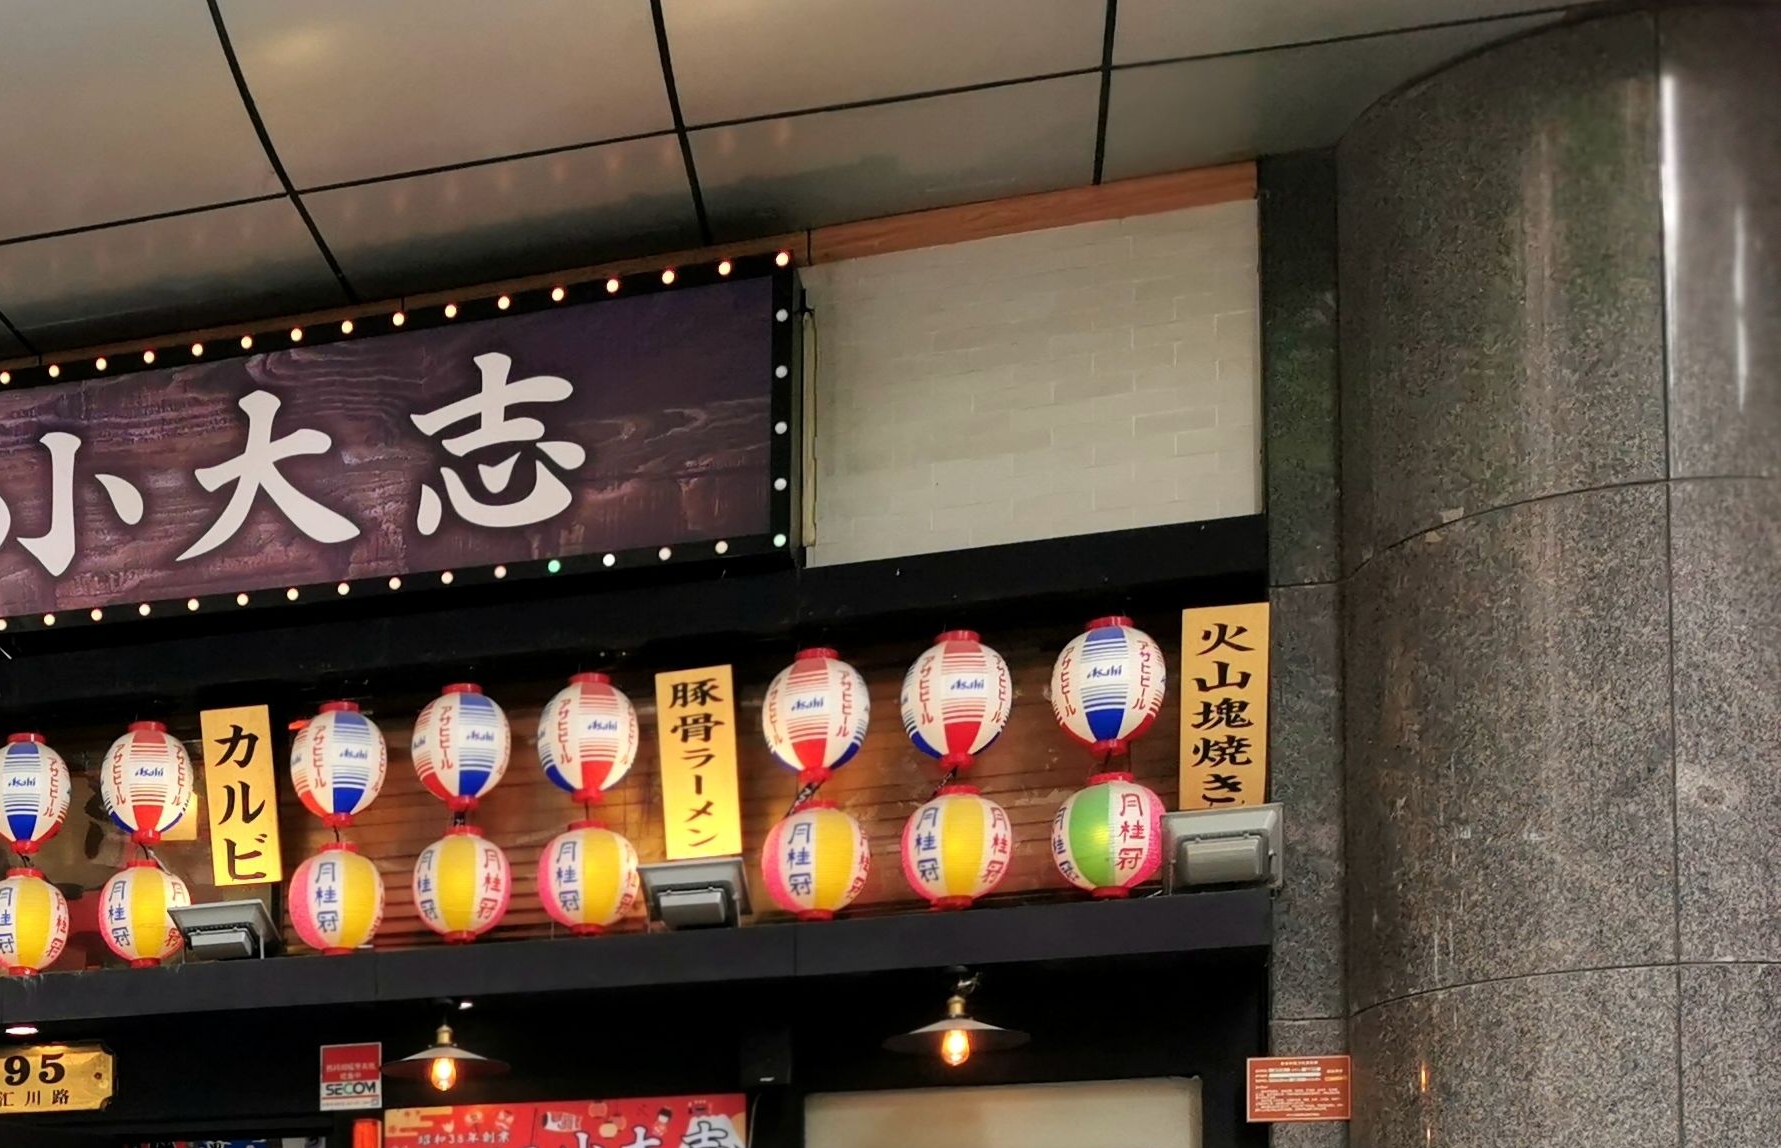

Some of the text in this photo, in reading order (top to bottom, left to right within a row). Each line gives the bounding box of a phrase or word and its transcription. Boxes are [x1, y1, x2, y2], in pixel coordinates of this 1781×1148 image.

[792, 697, 824, 710] Asahi
[836, 670, 855, 737] アサヒビール
[919, 655, 934, 725] アサヒビール
[951, 678, 984, 691] Asahi
[1060, 647, 1077, 717] アサヒビール
[1087, 665, 1122, 679] Asahi
[1133, 640, 1152, 711] アサヒビール
[438, 705, 453, 770] アサヒビール
[466, 729, 494, 742] Asahi
[558, 699, 572, 764] アサヒビール
[588, 720, 617, 731] Asahi
[1191, 621, 1255, 806] 火山塊焼き
[8, 776, 36, 788] Asahi
[44, 757, 60, 817] アサヒビール
[112, 743, 126, 805] アサヒビール
[135, 767, 164, 778] Asahi
[313, 725, 326, 788] アサヒビール
[340, 748, 368, 761] Asahi
[669, 681, 727, 847] 豚骨ラーメン
[214, 724, 268, 881] カルビ
[1117, 793, 1145, 871] 月桂冠
[556, 841, 579, 912] 月桂冠
[787, 822, 812, 895] 月桂冠
[915, 807, 939, 882] 月桂冠
[982, 807, 1008, 884] 月桂冠
[108, 880, 131, 947] 月桂冠
[316, 862, 339, 933] 月桂冠
[477, 849, 501, 919] 月桂冠
[4, 1053, 65, 1086] 95
[325, 1082, 376, 1096] SECOM
